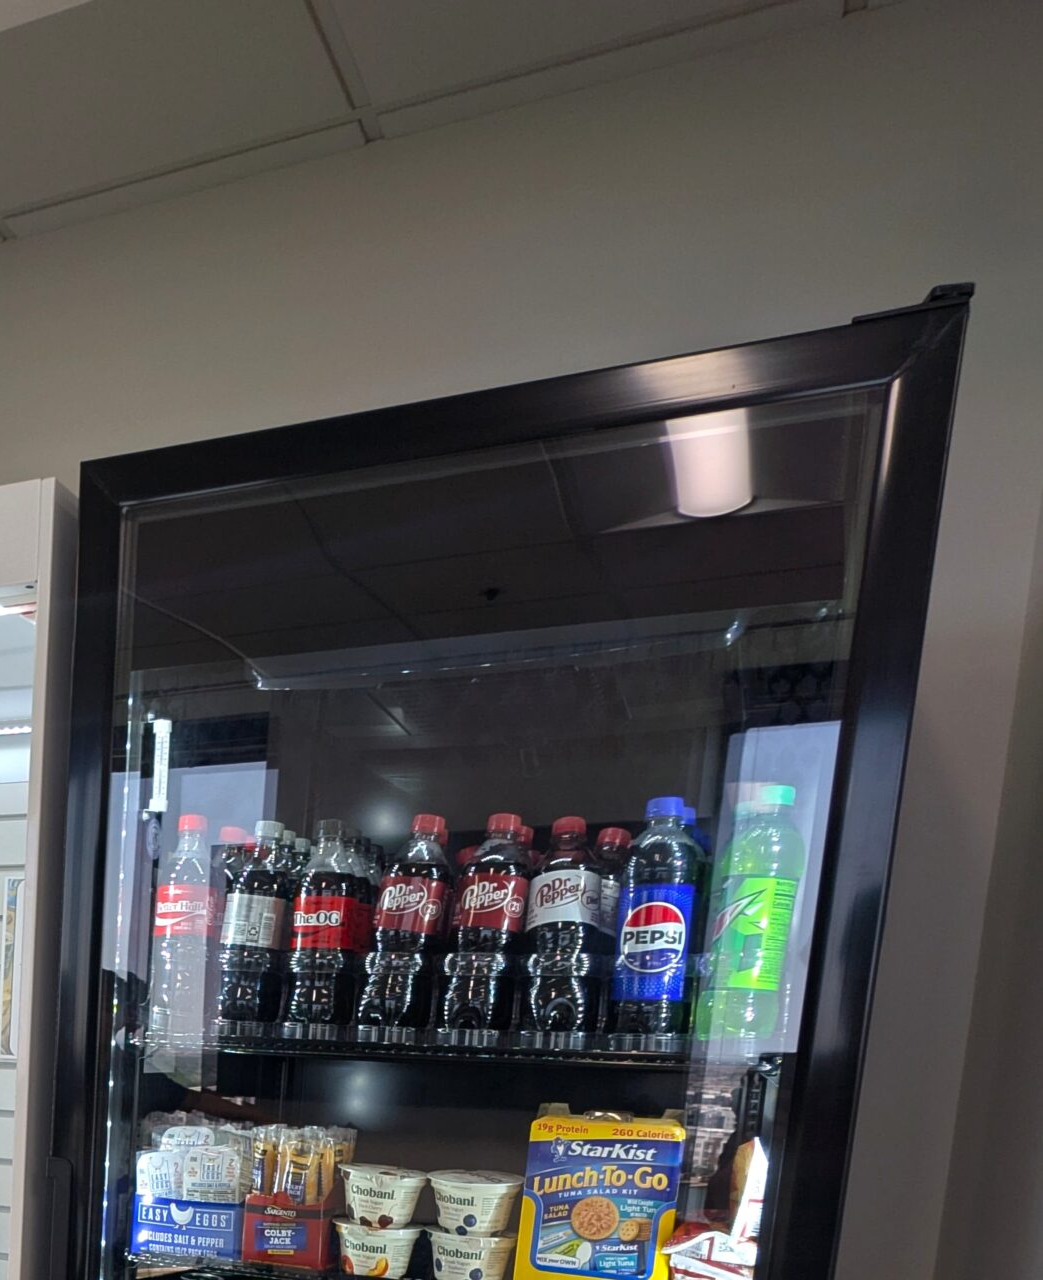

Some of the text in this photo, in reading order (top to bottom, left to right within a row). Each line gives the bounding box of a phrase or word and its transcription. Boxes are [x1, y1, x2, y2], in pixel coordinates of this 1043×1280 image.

[395, 883, 415, 897] Dr
[477, 881, 498, 894] Dr
[552, 877, 573, 890] Dr
[381, 885, 426, 911] Pepper
[463, 885, 508, 911] Pepper
[536, 883, 583, 909] Pepper
[294, 910, 342, 927] The OG
[622, 929, 683, 946] PEPSI
[536, 1122, 676, 1140] 19g Protein 260 Calories
[567, 1140, 658, 1162] StarKist
[350, 1182, 396, 1201] Chobani
[435, 1190, 477, 1208] Chobani
[557, 1189, 584, 1199] TUNA
[586, 1188, 619, 1196] SALAD
[264, 1205, 298, 1218] SARGENTO
[543, 1210, 569, 1220] SALAD
[548, 1204, 570, 1213] TUNA
[619, 1205, 657, 1214] Light Tun
[141, 1205, 228, 1228] EASY EGGS
[173, 1232, 226, 1249] SALT & PEPPER
[263, 1228, 296, 1238] COLBY-
[268, 1236, 292, 1246] JACK
[343, 1237, 388, 1255] Chobani
[601, 1243, 639, 1253] StarKist
[436, 1244, 484, 1262] Chobani
[558, 1258, 577, 1267] OWN
[599, 1258, 635, 1268] Light Tuna
